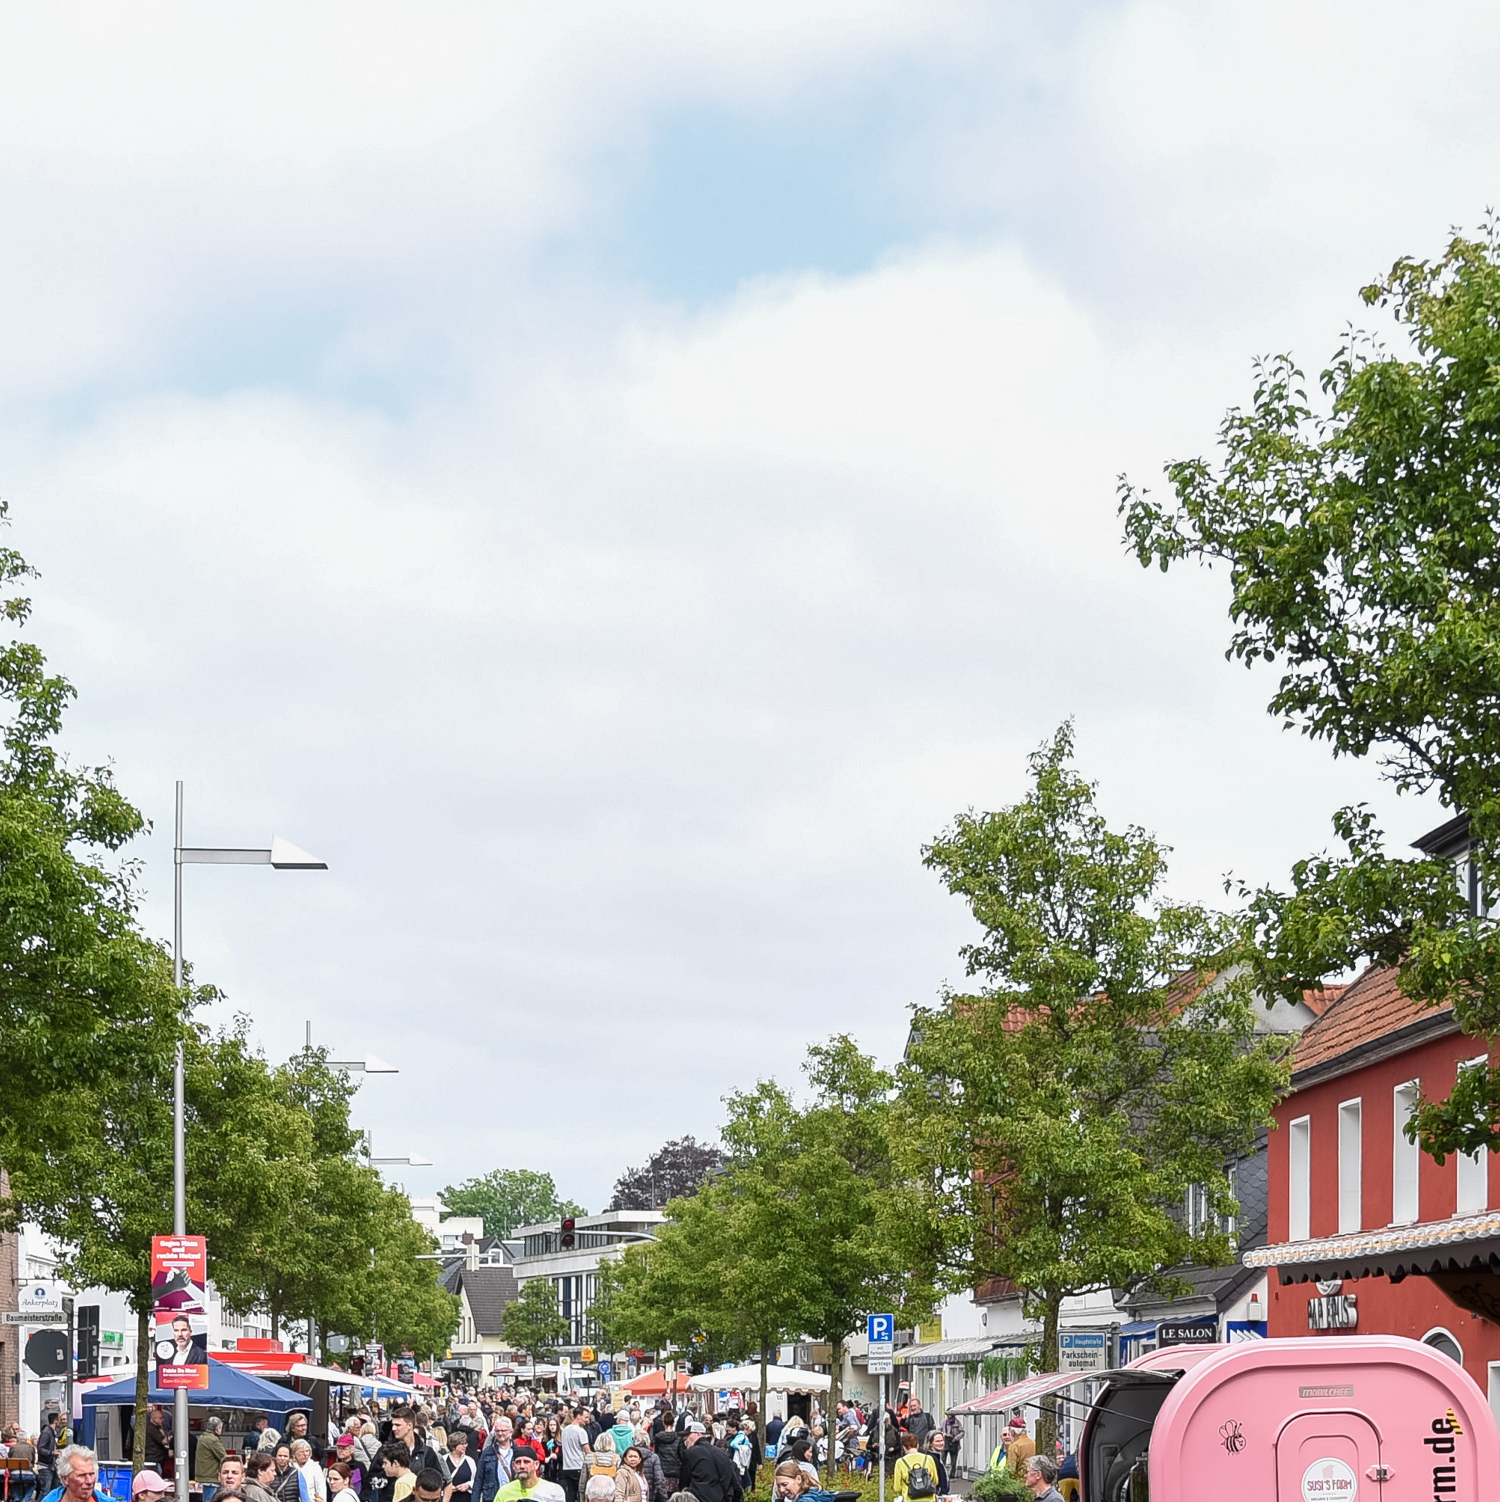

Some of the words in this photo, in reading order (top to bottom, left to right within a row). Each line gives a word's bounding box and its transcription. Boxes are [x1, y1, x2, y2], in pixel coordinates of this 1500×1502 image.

[21, 1299, 59, 1308] Ankerplatz
[6, 1313, 63, 1322] Baumeisterstraße
[873, 1318, 887, 1340] P
[1162, 1329, 1176, 1338] LE
[1178, 1328, 1212, 1338] SALON
[1063, 1337, 1071, 1347] P
[1062, 1350, 1102, 1360] Parkschein-
[1068, 1359, 1096, 1367] automat
[1332, 1478, 1352, 1491] FARM
